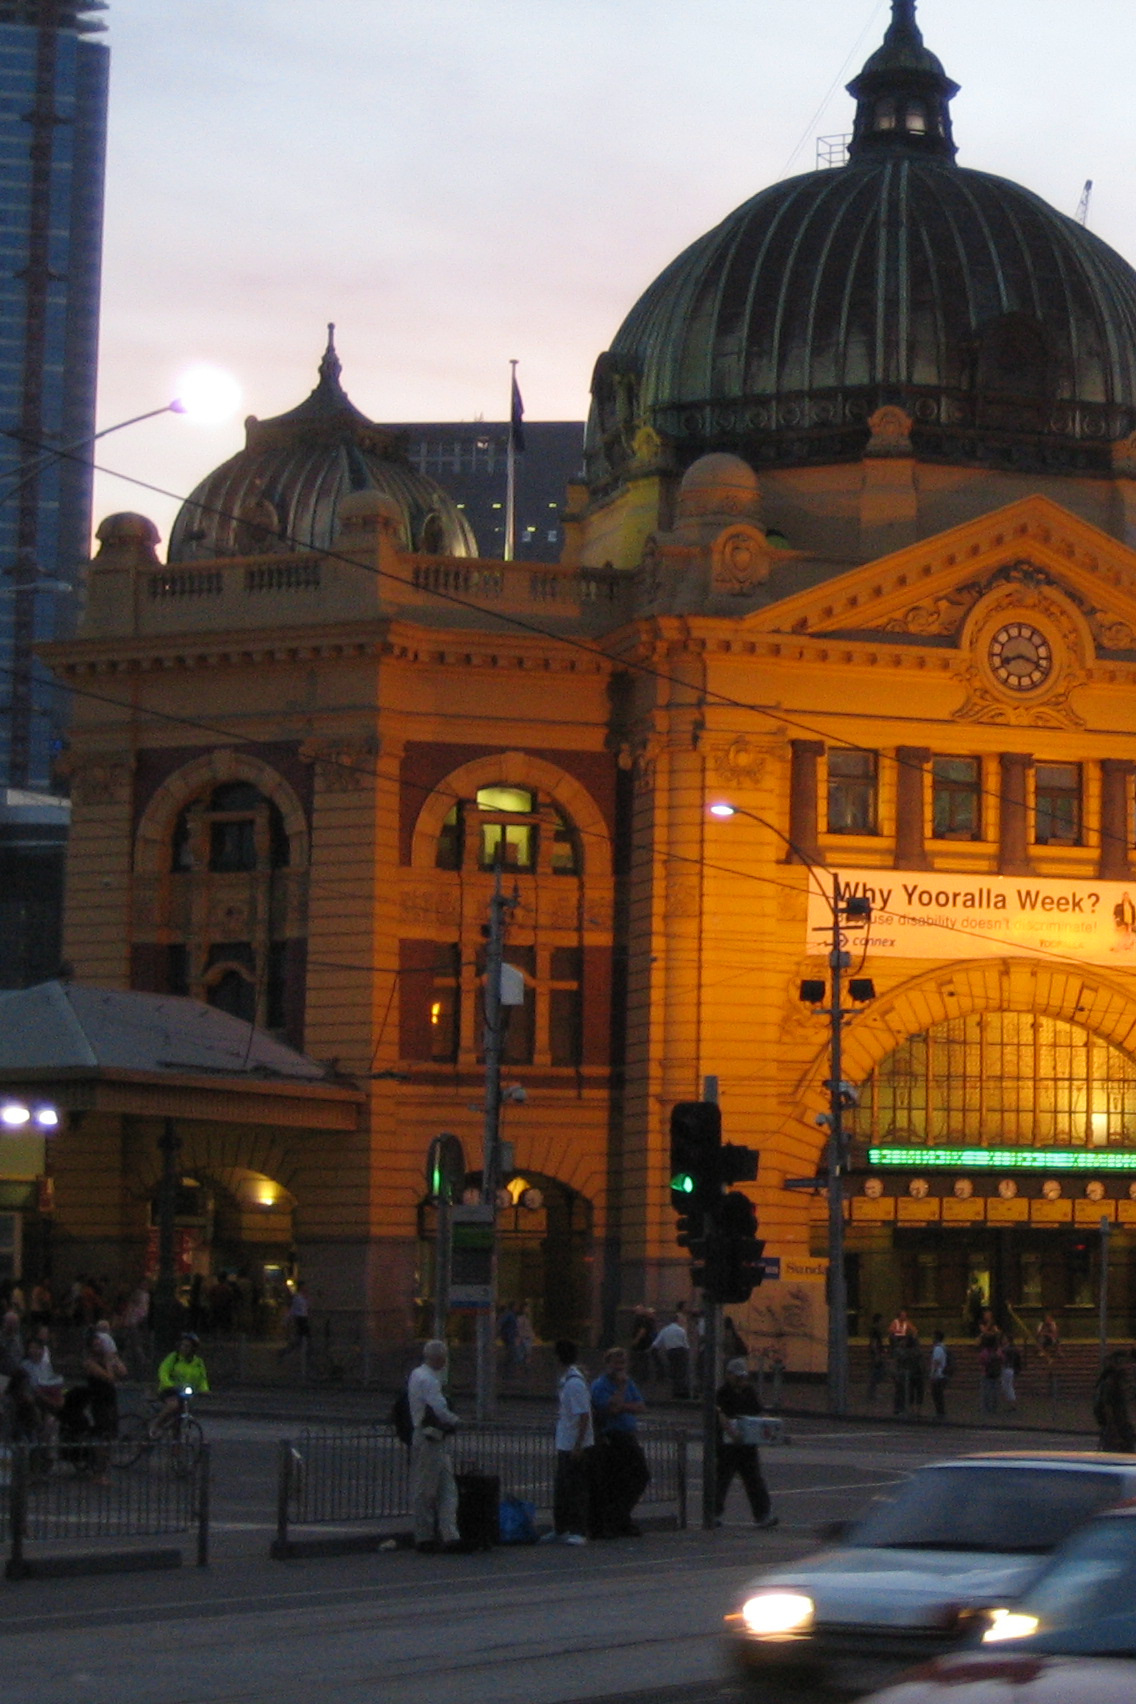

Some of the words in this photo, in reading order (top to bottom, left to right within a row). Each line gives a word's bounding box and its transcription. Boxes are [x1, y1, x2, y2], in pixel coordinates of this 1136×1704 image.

[838, 881, 892, 911] Why
[902, 884, 1007, 911] Yooralla
[1017, 889, 1100, 914] Week?
[898, 913, 956, 930] disability
[961, 916, 1010, 930] doesn't
[852, 936, 895, 948] connex
